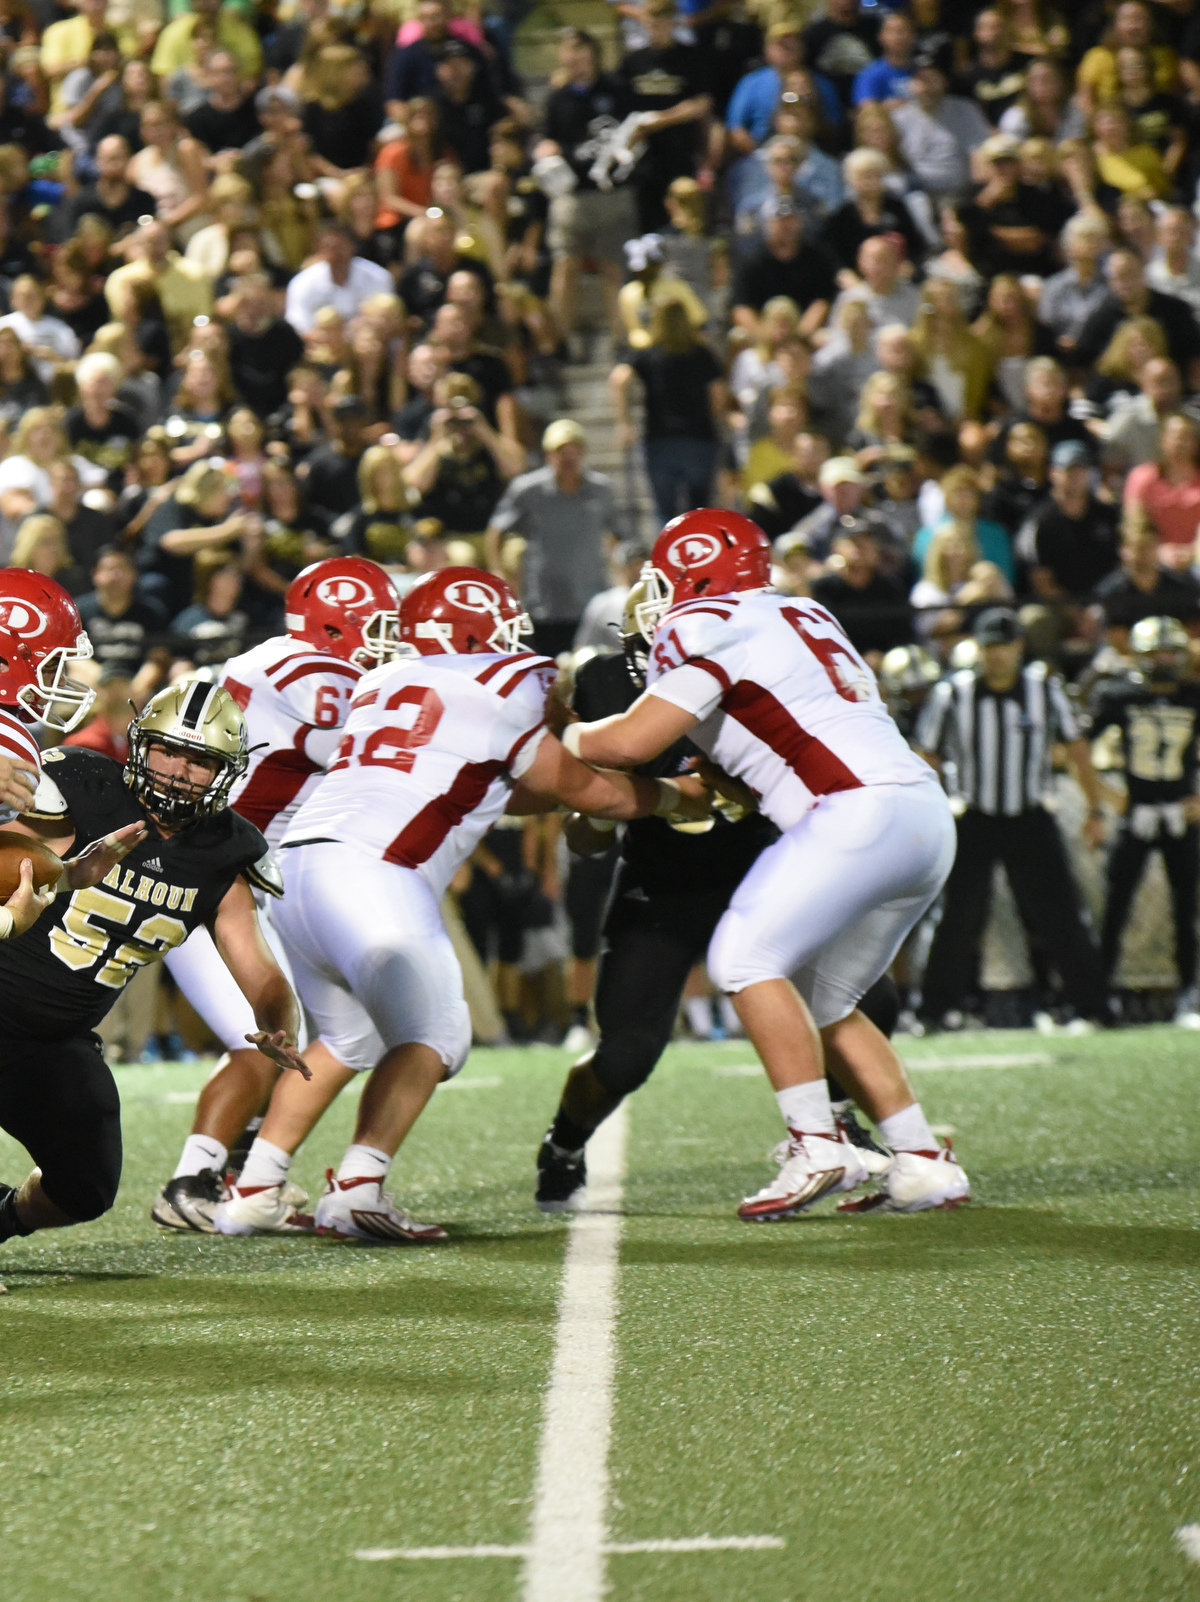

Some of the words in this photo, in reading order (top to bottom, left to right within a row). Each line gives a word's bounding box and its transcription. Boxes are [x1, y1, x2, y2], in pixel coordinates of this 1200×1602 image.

[322, 579, 369, 606] D
[449, 583, 497, 610] D
[172, 727, 202, 742] ddell
[41, 747, 66, 765] 2
[142, 861, 163, 874] adidas
[102, 863, 199, 912] ALHOUN
[49, 886, 188, 989] 52
